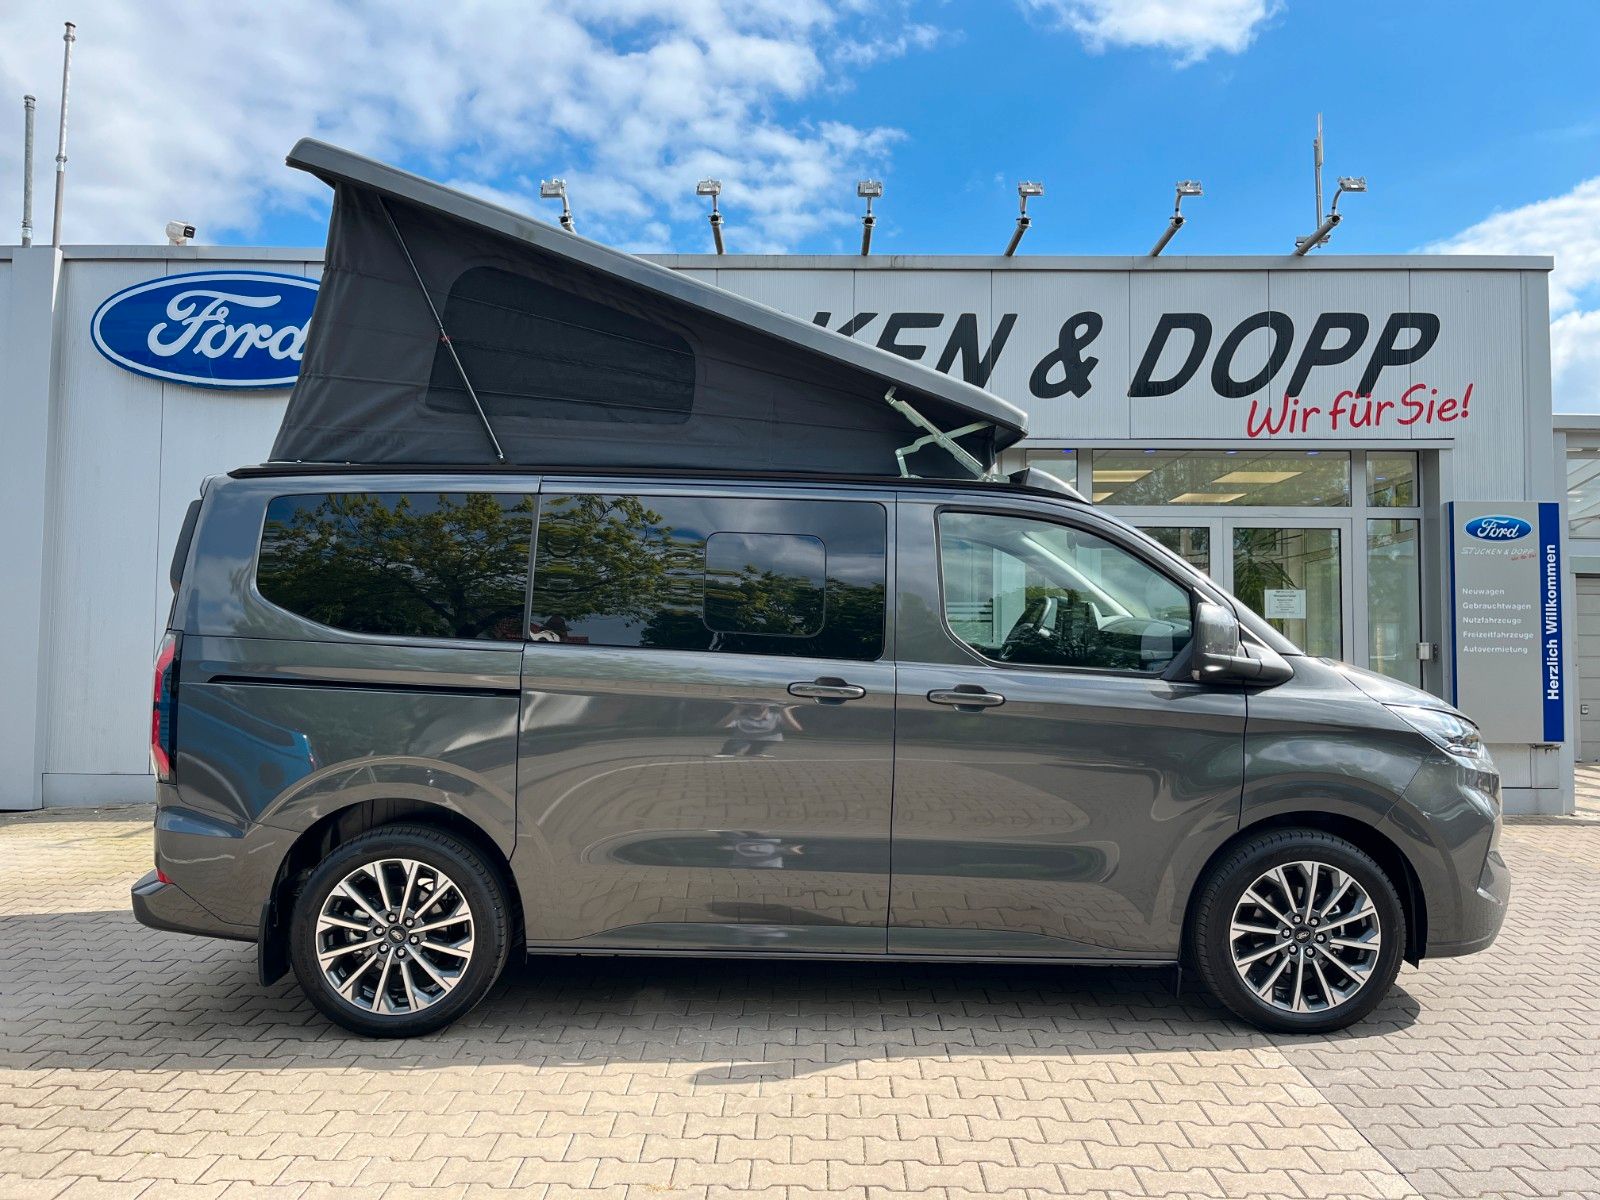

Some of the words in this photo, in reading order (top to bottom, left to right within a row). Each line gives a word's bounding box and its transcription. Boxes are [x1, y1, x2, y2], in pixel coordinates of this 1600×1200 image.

[147, 289, 312, 361] Ford
[1028, 311, 1103, 399] &
[1127, 311, 1440, 399] DOPP
[1247, 393, 1320, 438] Wir
[1329, 390, 1395, 431] für
[1397, 383, 1474, 426] Sie!
[1477, 518, 1520, 538] Ford
[1462, 587, 1505, 596] Neuwagen
[1545, 544, 1558, 635] Willkommen
[1462, 602, 1532, 611] Gebrauchtwagen
[1462, 616, 1522, 625] Nutzfahrzeuge
[1463, 630, 1534, 640] Freizeitfahrzeuge
[1463, 645, 1528, 654] Autovermietung
[1546, 639, 1559, 700] Herzlich
